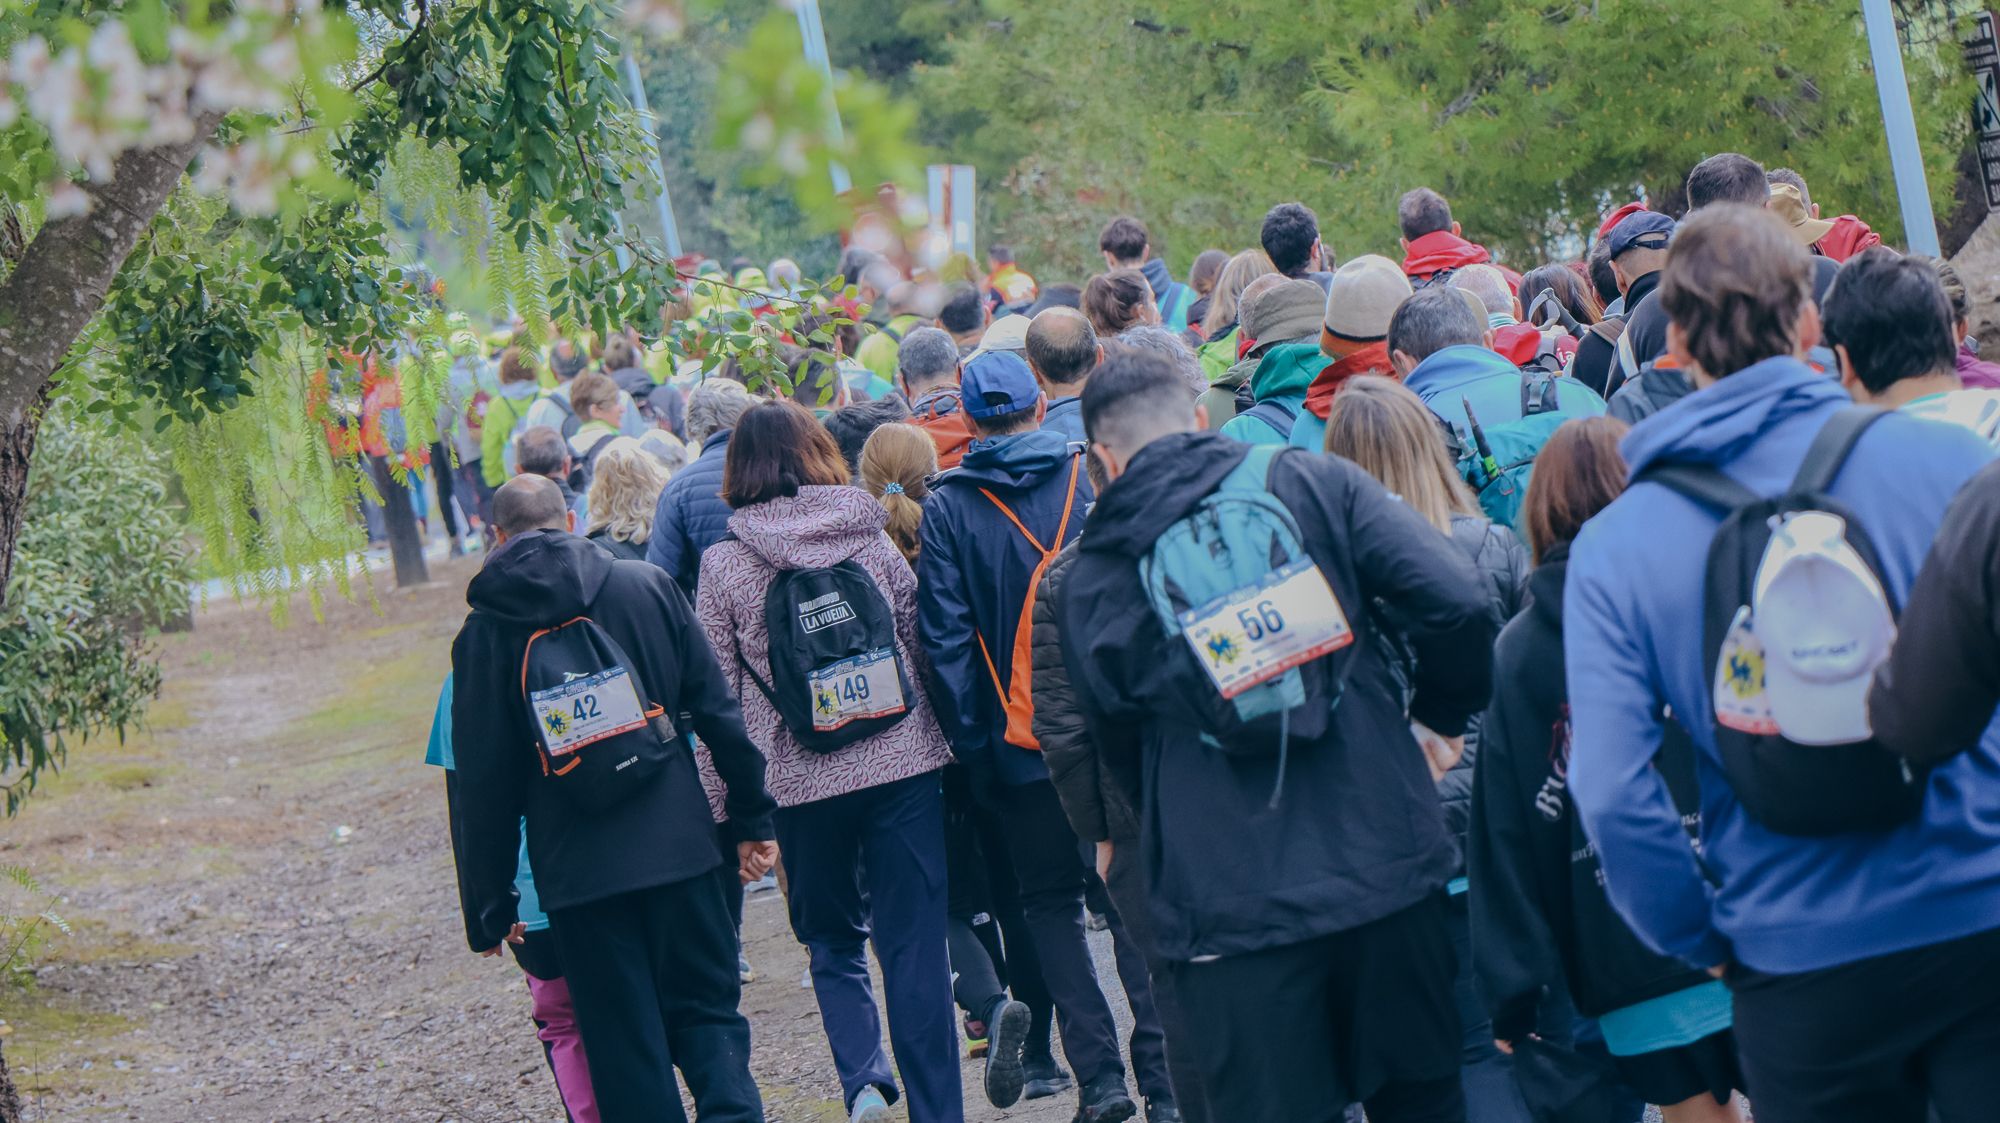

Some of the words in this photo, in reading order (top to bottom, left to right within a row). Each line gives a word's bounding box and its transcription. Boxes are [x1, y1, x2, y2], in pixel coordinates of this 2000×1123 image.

[805, 615, 820, 630] LA
[817, 605, 850, 625] VUELTA
[1236, 600, 1285, 641] 56
[834, 674, 870, 707] 149
[573, 694, 602, 721] 42
